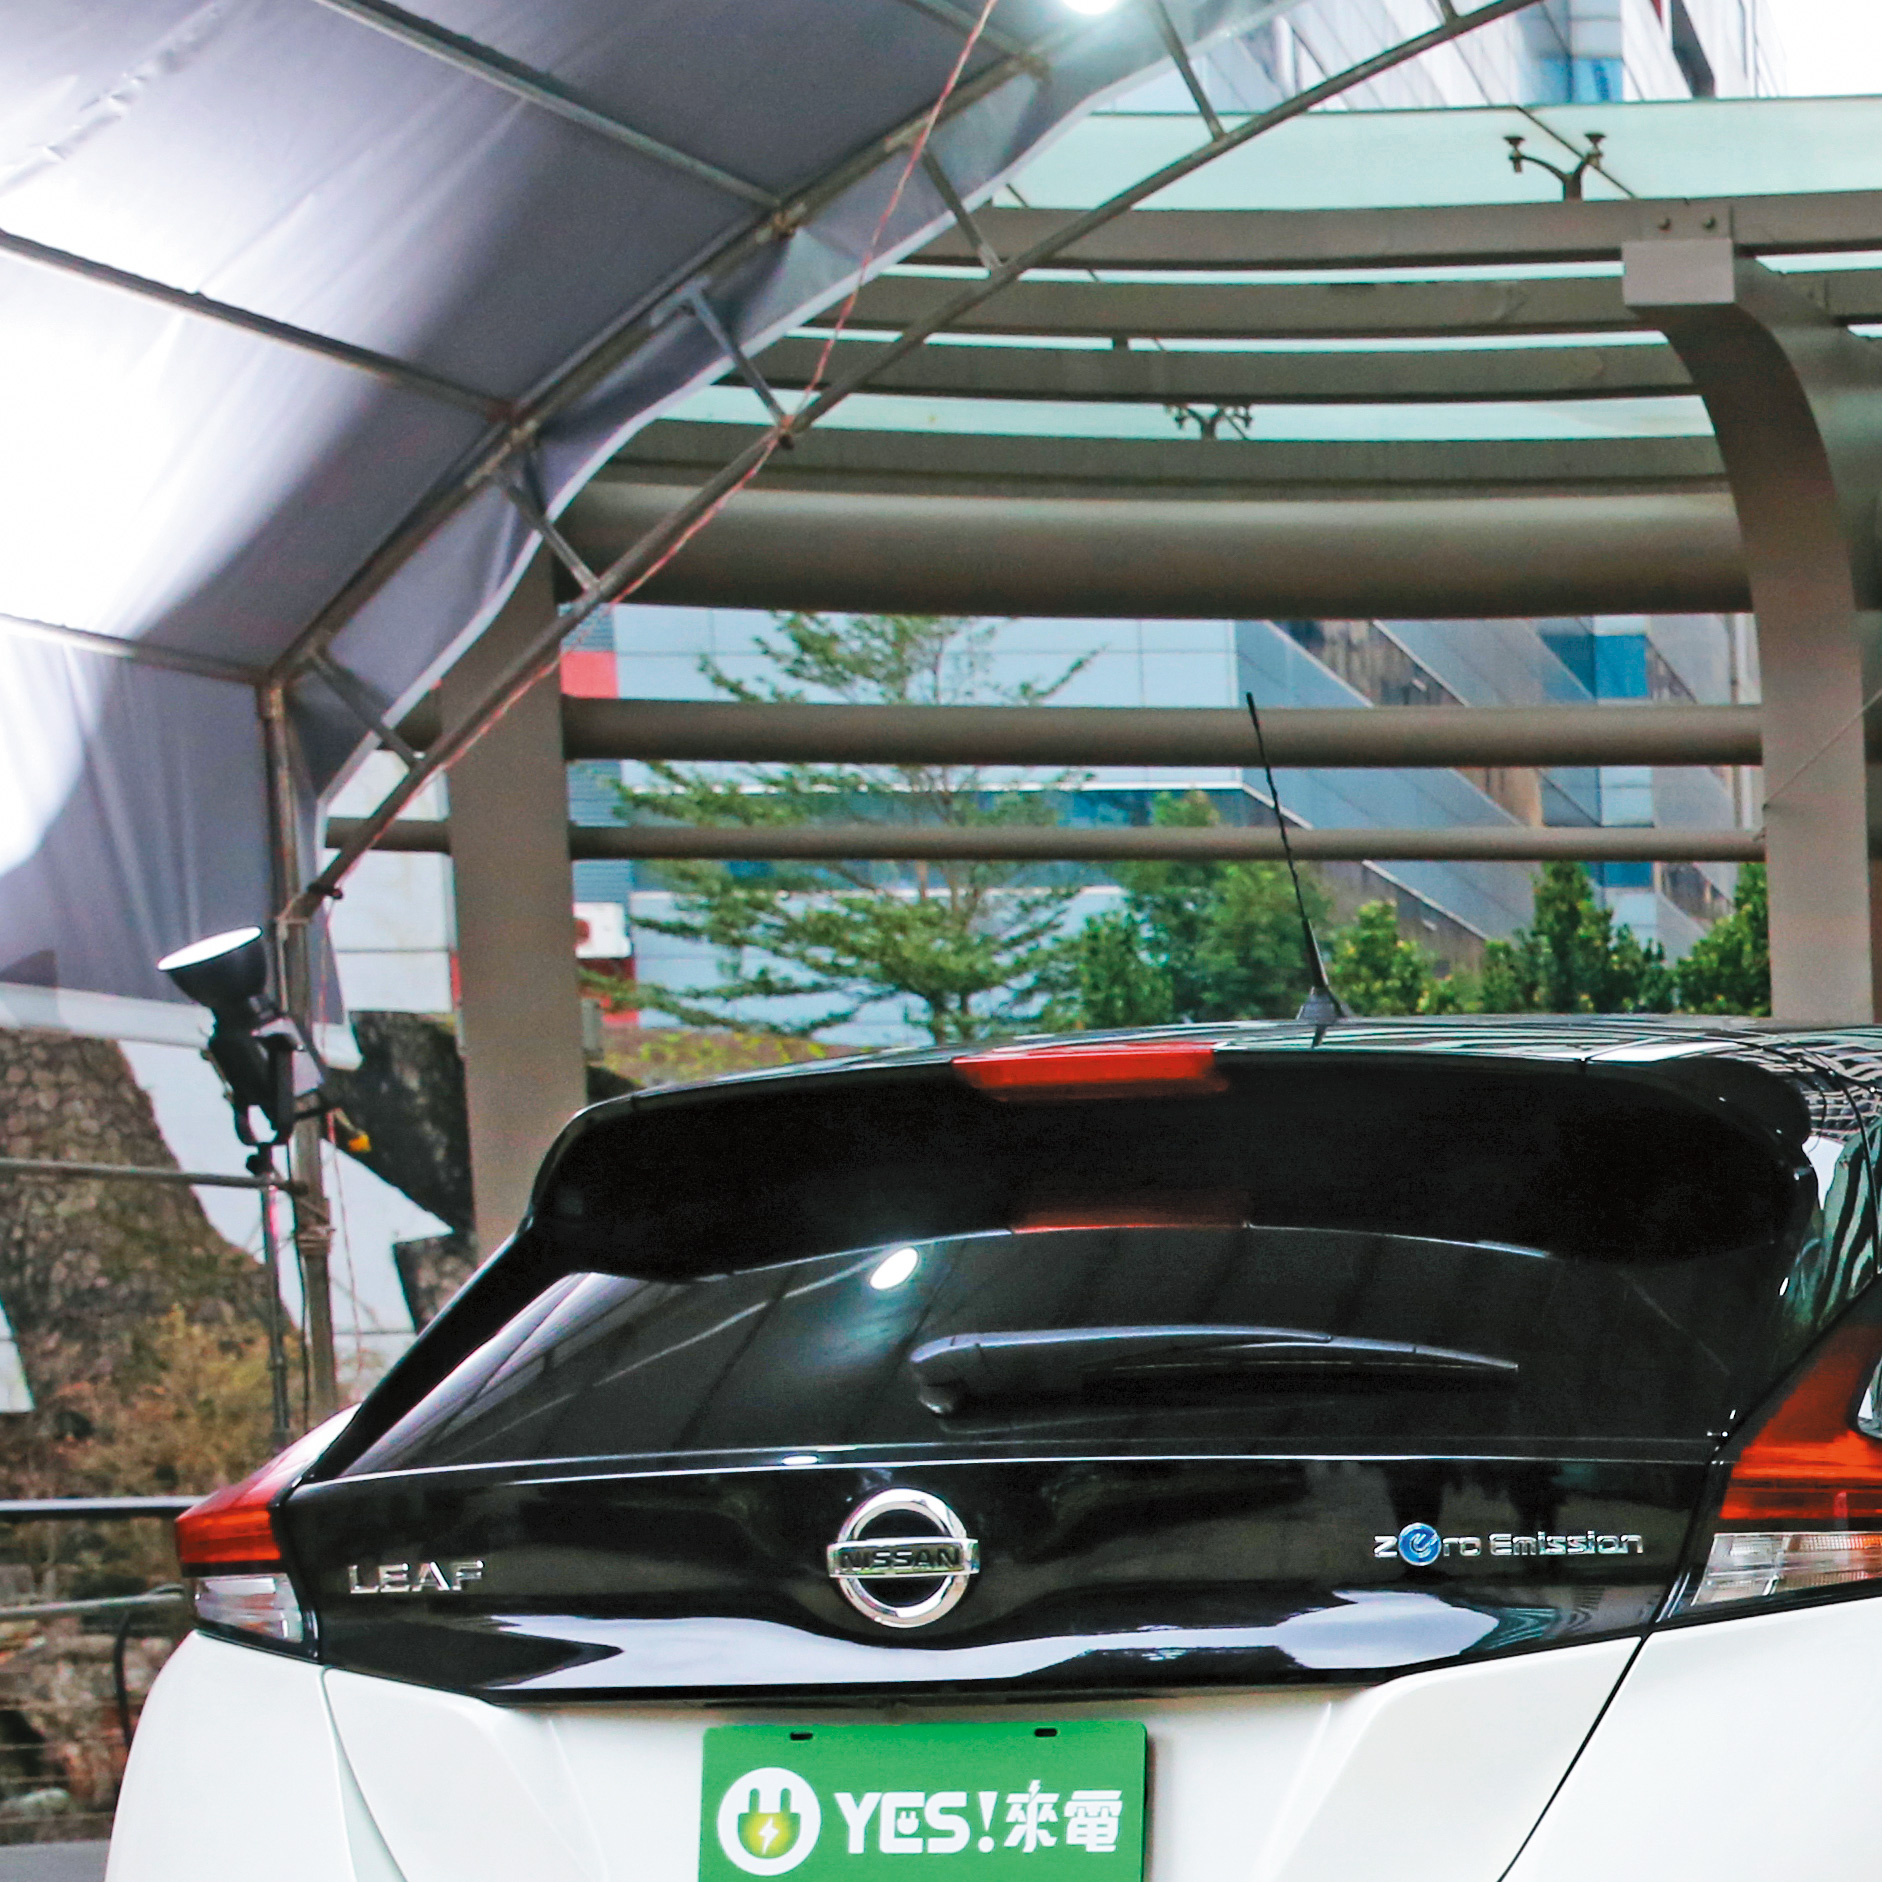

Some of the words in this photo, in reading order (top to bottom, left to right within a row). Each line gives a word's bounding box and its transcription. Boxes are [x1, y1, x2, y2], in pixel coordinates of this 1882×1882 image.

[1488, 1530, 1644, 1556] Emission
[840, 1548, 961, 1571] NISSAN
[348, 1560, 485, 1595] LEAF
